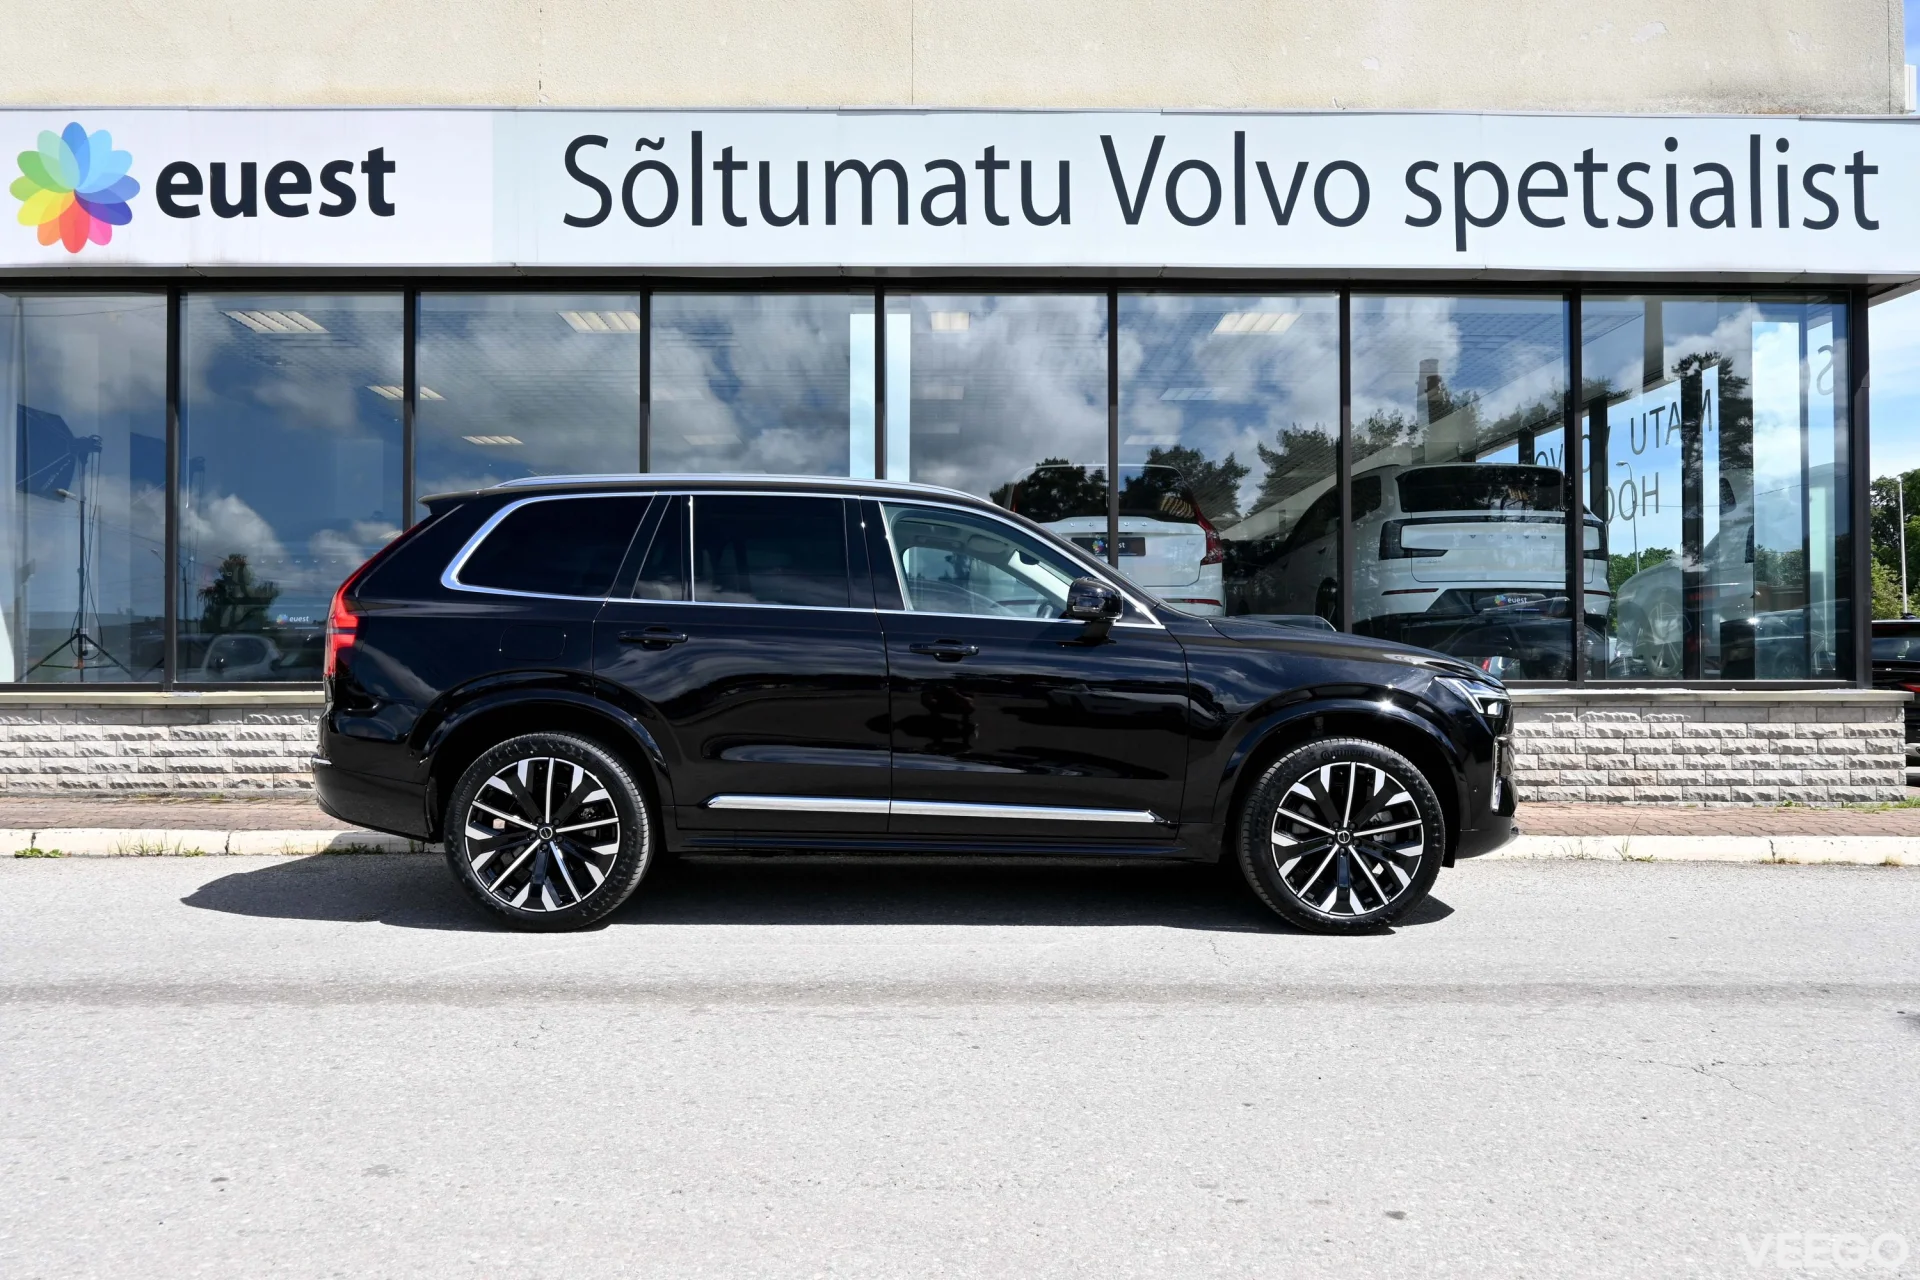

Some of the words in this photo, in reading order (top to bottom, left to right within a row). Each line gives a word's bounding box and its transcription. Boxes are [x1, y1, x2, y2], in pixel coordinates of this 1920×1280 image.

[155, 146, 396, 219] euest
[563, 130, 1071, 228] Sõltumatu
[1099, 130, 1370, 228] Volvo
[1404, 134, 1880, 252] spetsialist
[1507, 596, 1528, 604] euest
